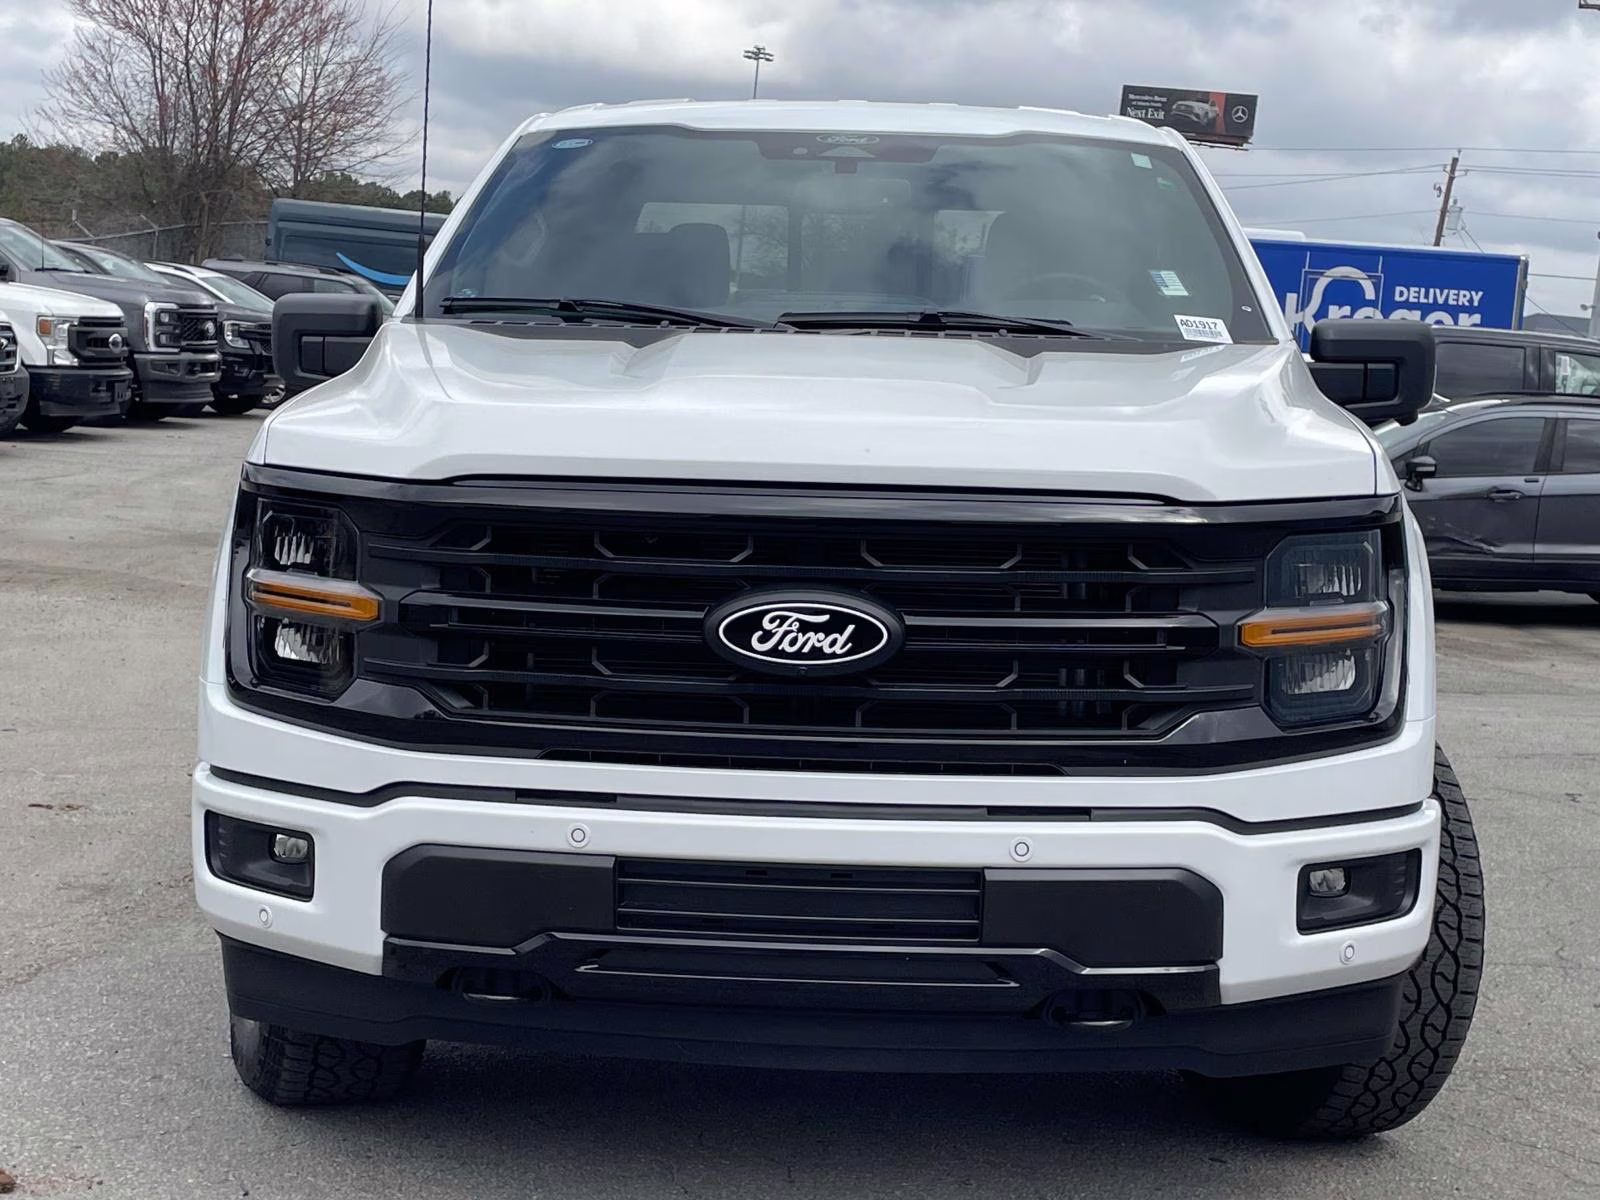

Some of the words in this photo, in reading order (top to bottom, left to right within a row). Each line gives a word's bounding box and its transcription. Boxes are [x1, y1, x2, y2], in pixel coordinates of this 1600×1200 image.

[1127, 107, 1146, 119] Next
[1147, 108, 1165, 120] Exit
[1394, 286, 1484, 307] DELIVERY
[751, 611, 856, 654] Ford
